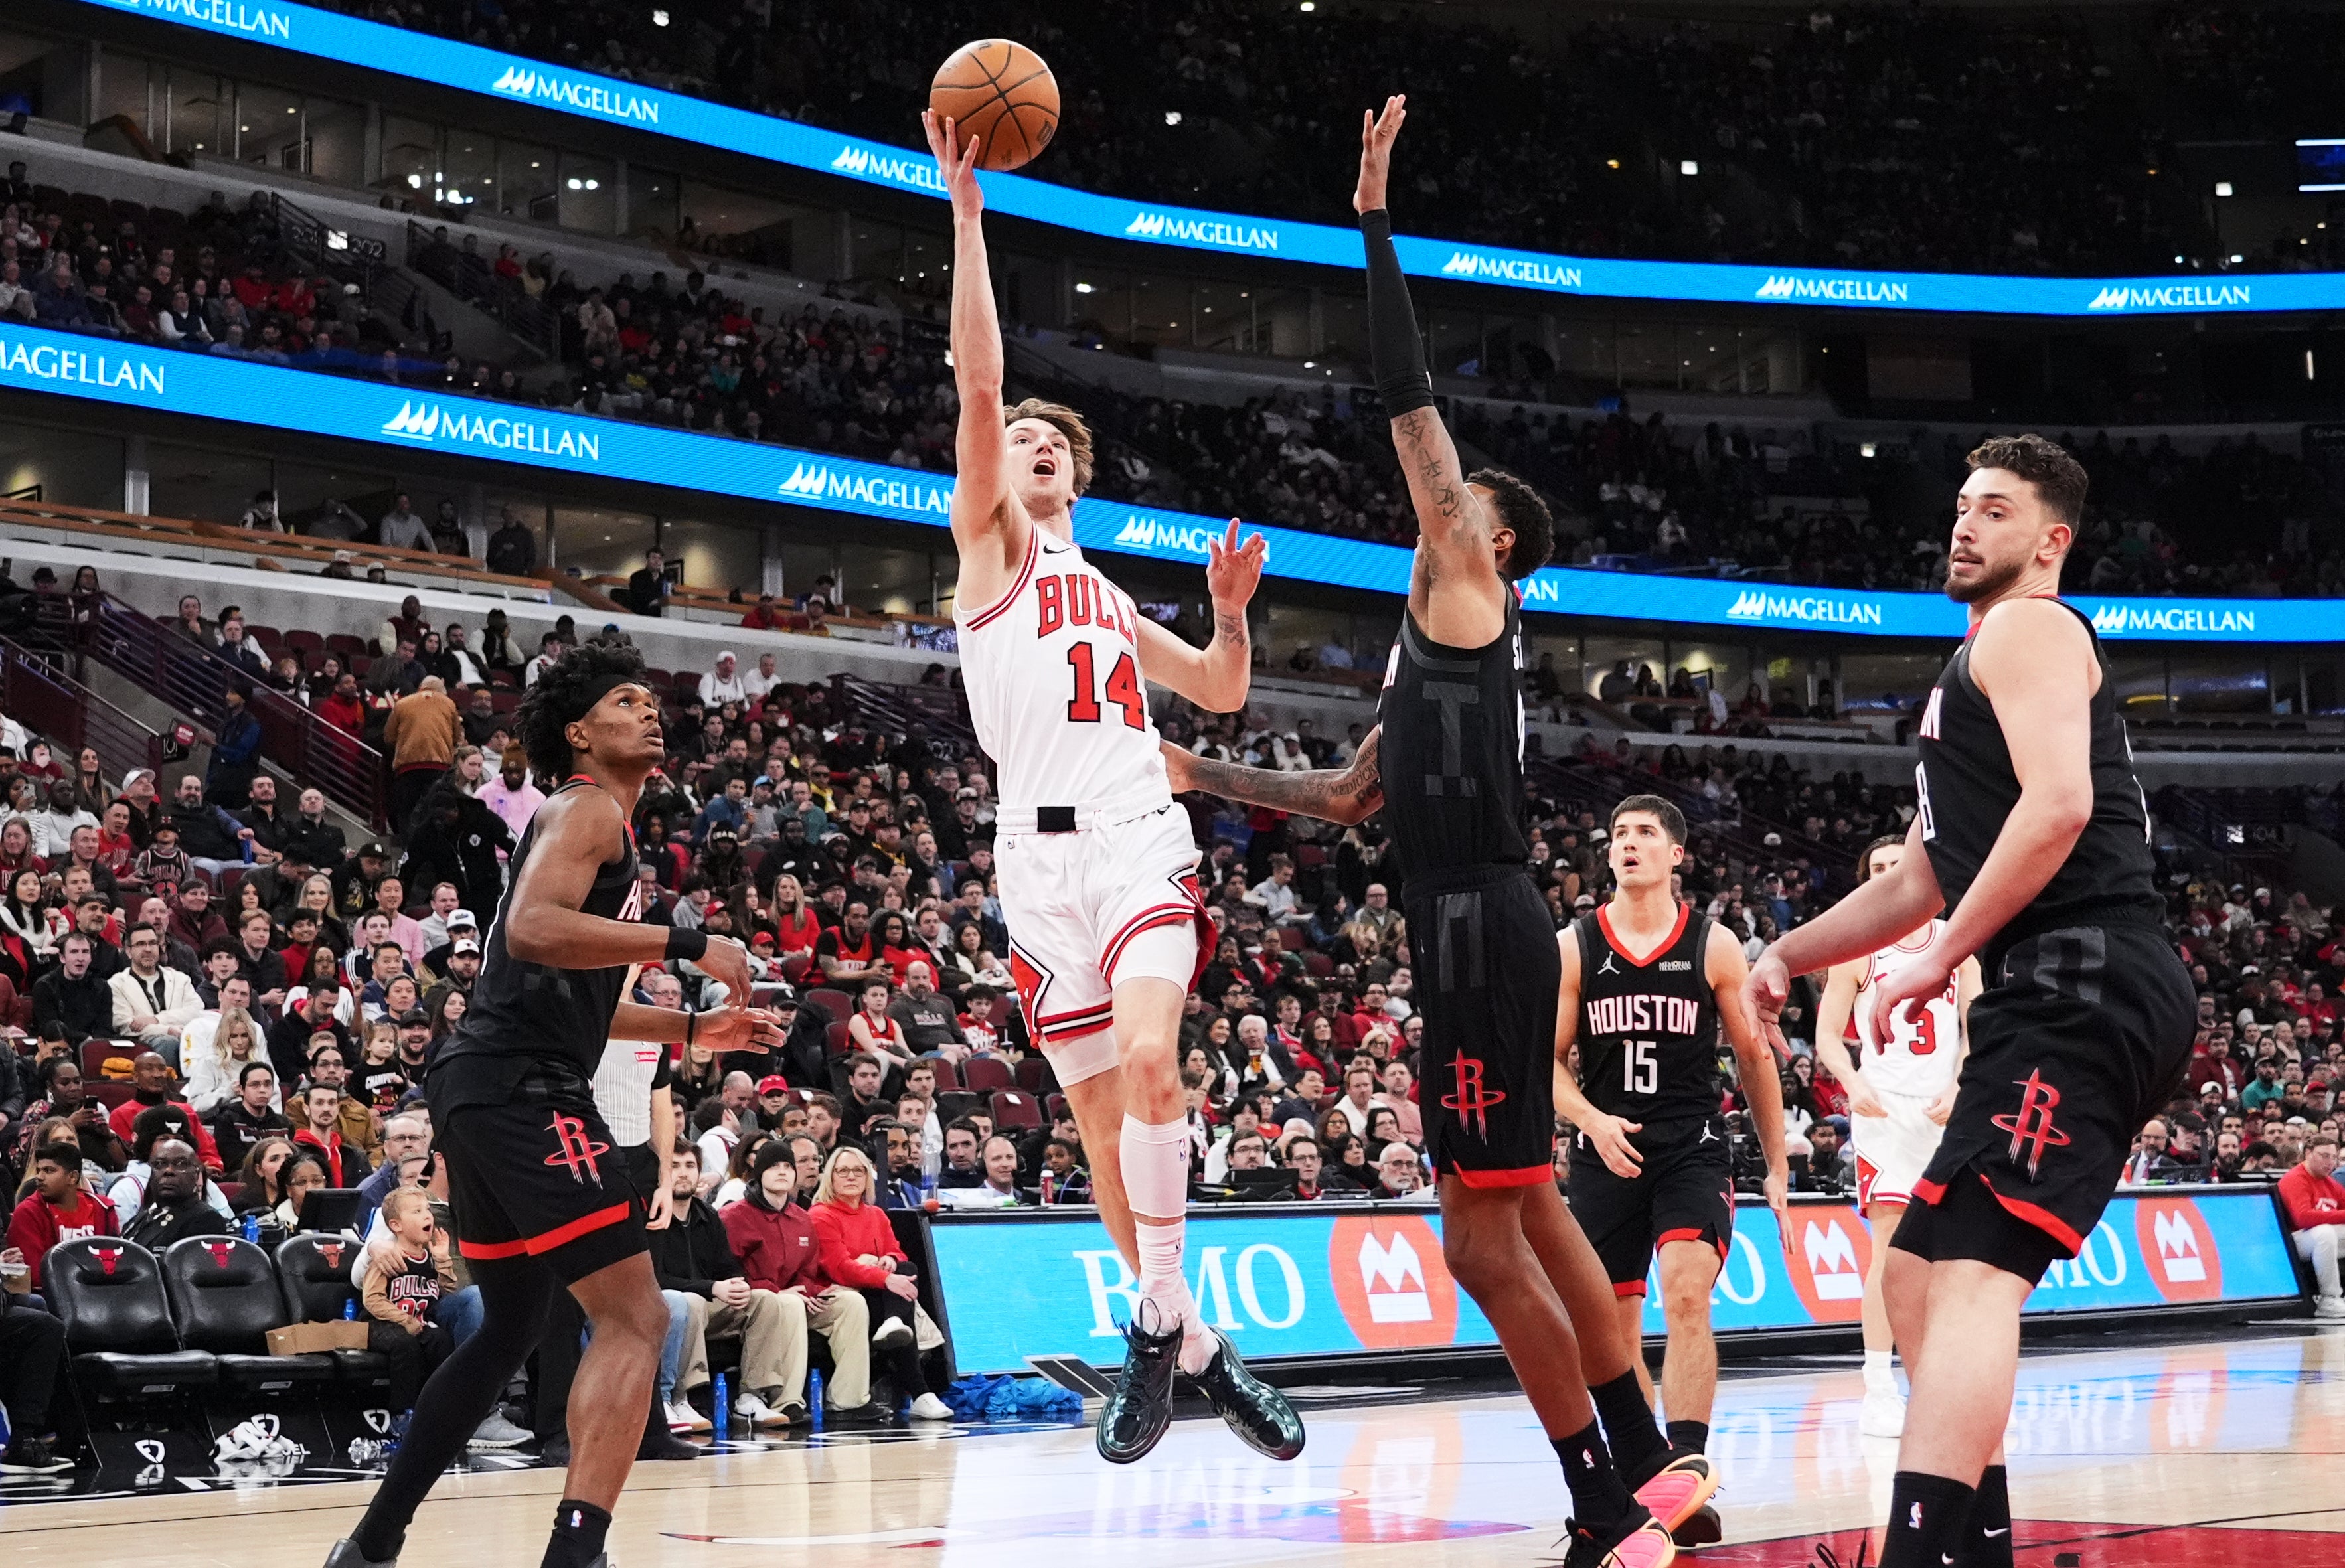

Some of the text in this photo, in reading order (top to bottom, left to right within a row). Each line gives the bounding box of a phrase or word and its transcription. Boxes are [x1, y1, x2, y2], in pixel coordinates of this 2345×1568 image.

[536, 74, 659, 124] MAGELLAN
[868, 153, 949, 192] MAGELL
[1165, 217, 1278, 251] MAGELLAN
[1477, 257, 1582, 288] MAGELLAN
[1795, 278, 1908, 302] MAGELLAN
[2130, 285, 2251, 307] MAGELLAN
[441, 411, 600, 461] MAGELLAN
[1766, 596, 1882, 625] MAGELLAN
[2129, 608, 2255, 631] MAGELLAN
[1067, 640, 1146, 732] 14
[1587, 994, 1699, 1036] HOUSTON
[1909, 1008, 1936, 1055] 3
[1623, 1039, 1658, 1095] 15
[390, 1275, 440, 1302] BULLS
